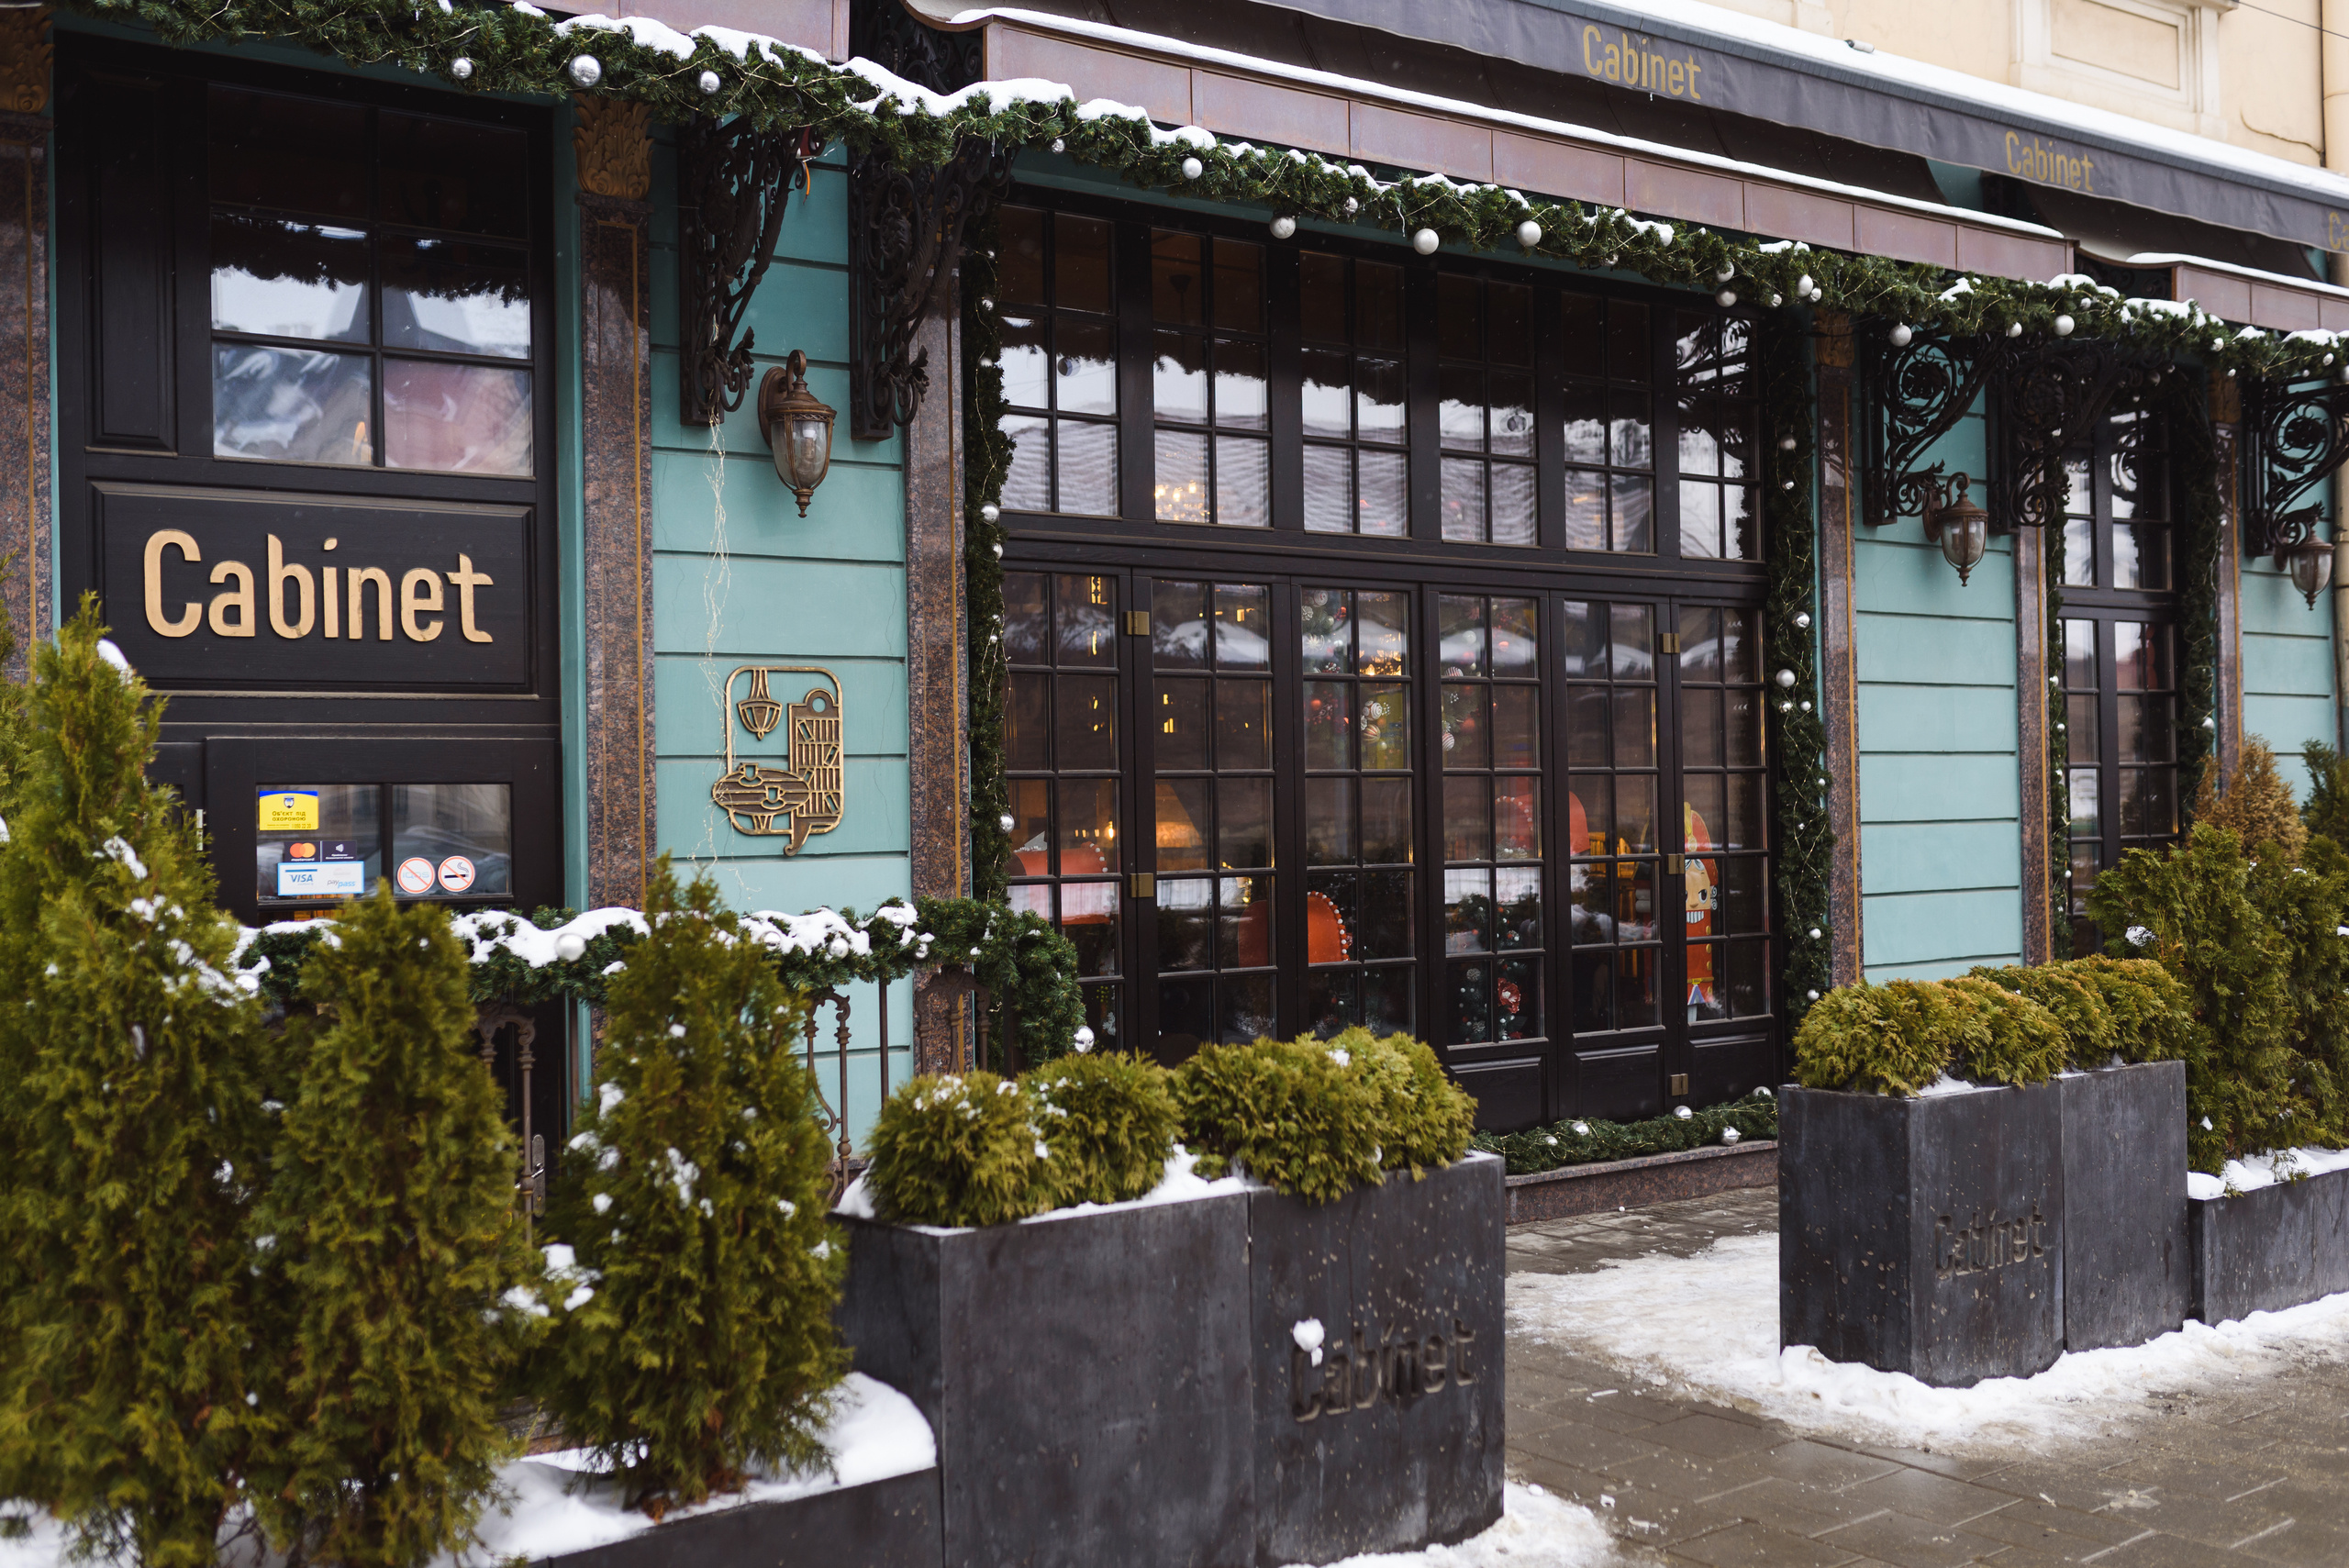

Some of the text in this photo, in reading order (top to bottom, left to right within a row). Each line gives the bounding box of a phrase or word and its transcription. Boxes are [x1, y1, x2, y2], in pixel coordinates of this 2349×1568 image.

[1583, 25, 1702, 99] Cabinet
[2005, 130, 2094, 192] Cabinet
[144, 528, 494, 642] Cabinet
[290, 874, 313, 883] VISA
[1934, 1204, 2045, 1280] Cabinet
[1291, 1318, 1475, 1422] Cabinet
